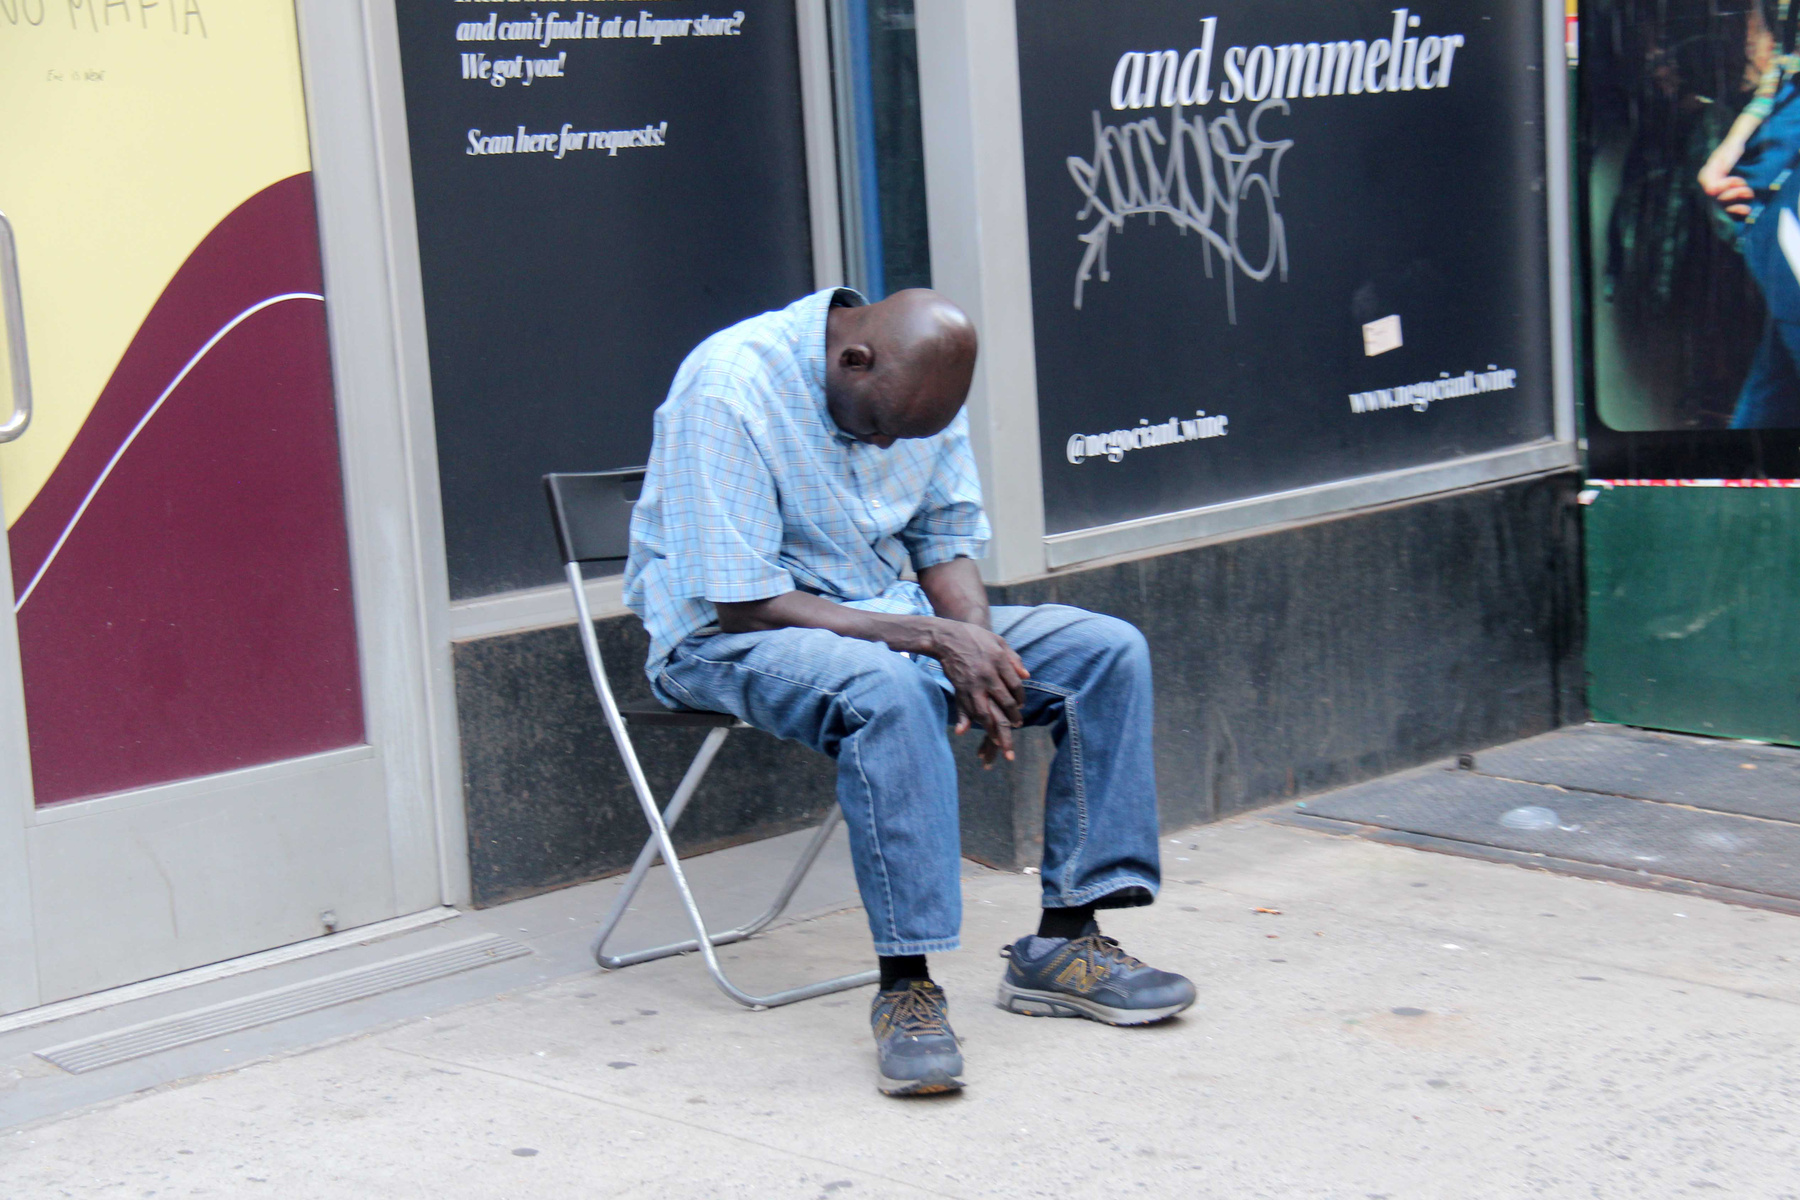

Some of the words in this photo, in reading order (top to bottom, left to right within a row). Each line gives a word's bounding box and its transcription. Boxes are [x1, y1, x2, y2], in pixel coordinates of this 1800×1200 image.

[456, 12, 498, 41] and
[498, 12, 544, 41] can't
[539, 11, 585, 48] find
[584, 13, 601, 39] it
[600, 15, 622, 39] at
[622, 19, 638, 39] a
[637, 10, 693, 45] liquor
[691, 10, 746, 36] store?
[460, 52, 492, 80] We
[490, 55, 524, 88] got
[521, 51, 567, 87] you!
[1109, 16, 1218, 111] and
[1218, 8, 1465, 104] sommelier
[466, 128, 515, 156] Scan
[515, 125, 559, 153] here
[554, 123, 588, 160] for
[587, 121, 668, 157] requests!
